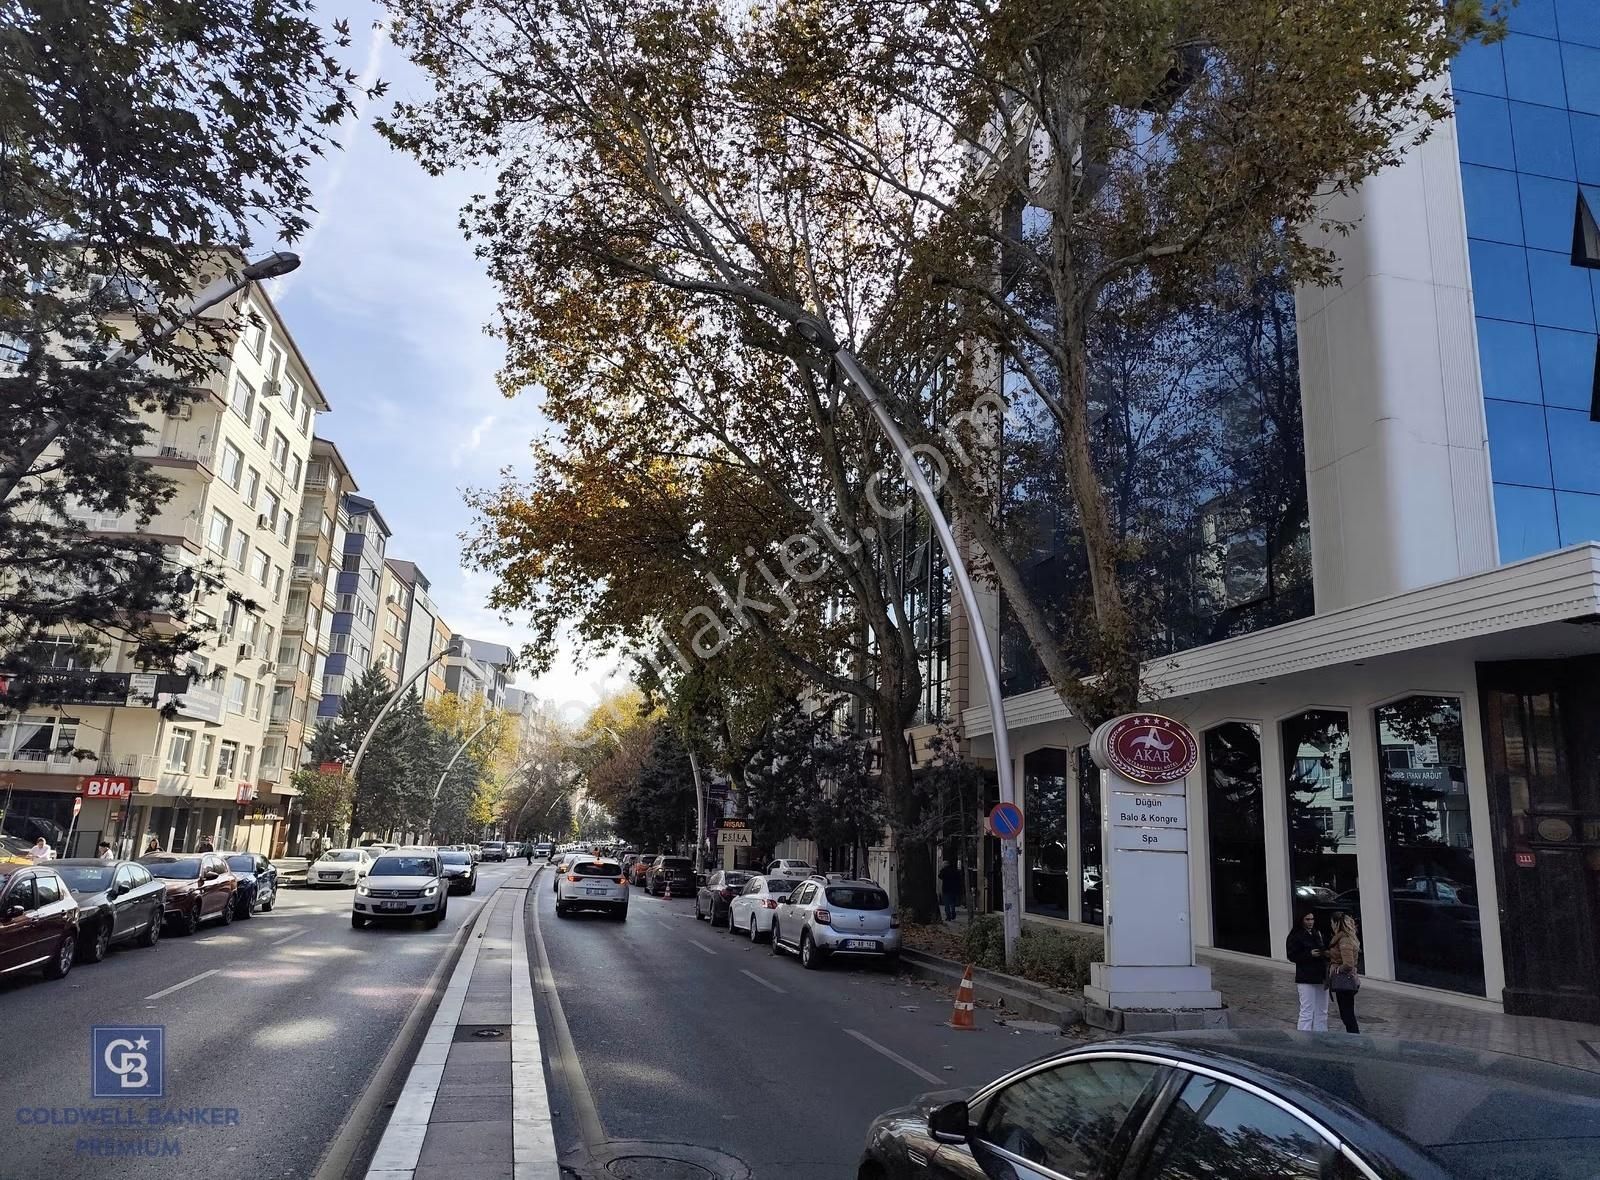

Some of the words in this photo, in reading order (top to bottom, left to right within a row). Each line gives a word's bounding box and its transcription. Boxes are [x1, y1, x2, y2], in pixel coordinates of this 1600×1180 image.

[1133, 748, 1172, 763] AKAR
[1126, 757, 1163, 771] INTERNATIONAL
[1163, 761, 1179, 770] HOTEL
[87, 777, 125, 796] BİM
[1120, 813, 1139, 822] Balo
[1140, 813, 1147, 822] &
[1149, 814, 1178, 825] Kongre
[1142, 834, 1158, 844] Spa
[1519, 855, 1532, 863] 111
